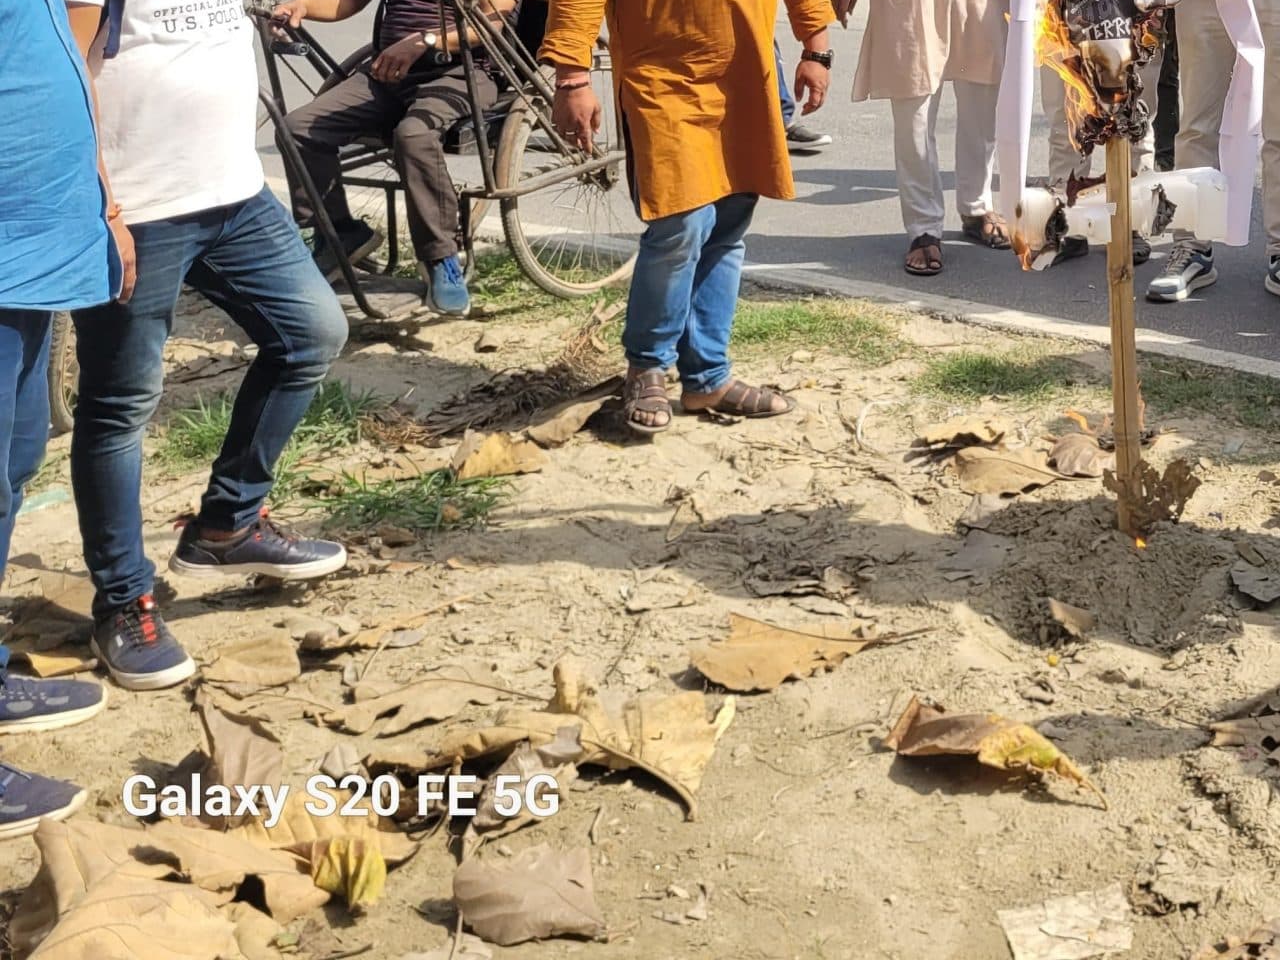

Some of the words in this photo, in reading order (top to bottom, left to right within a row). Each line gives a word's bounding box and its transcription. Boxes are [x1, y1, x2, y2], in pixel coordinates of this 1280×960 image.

[153, 1, 213, 18] OFFICIAL
[161, 16, 204, 33] U.S.
[207, 7, 239, 28] POLO
